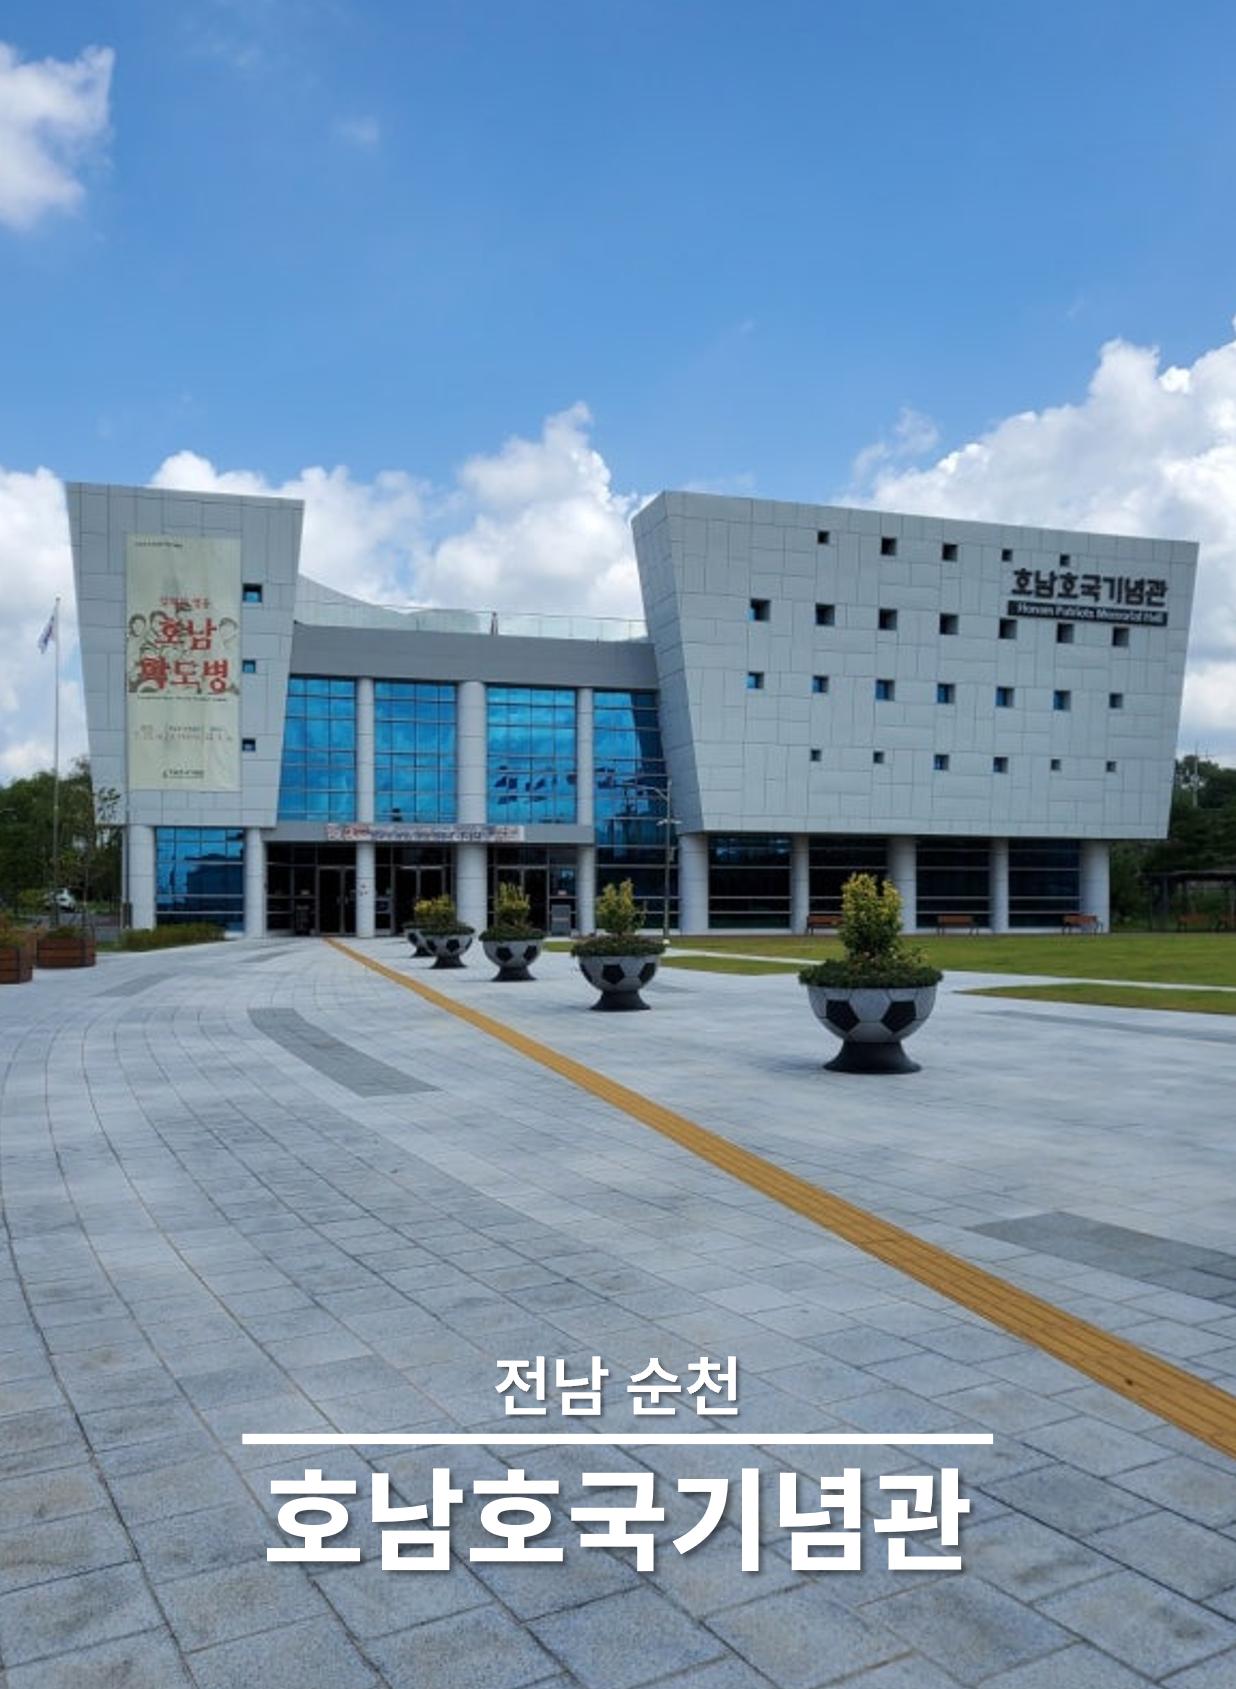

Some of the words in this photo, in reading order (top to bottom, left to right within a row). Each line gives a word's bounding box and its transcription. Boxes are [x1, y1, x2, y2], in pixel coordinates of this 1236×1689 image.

[1011, 568, 1168, 607] 호남호국기념관
[155, 618, 217, 651] 호남
[140, 655, 228, 694] 학도병
